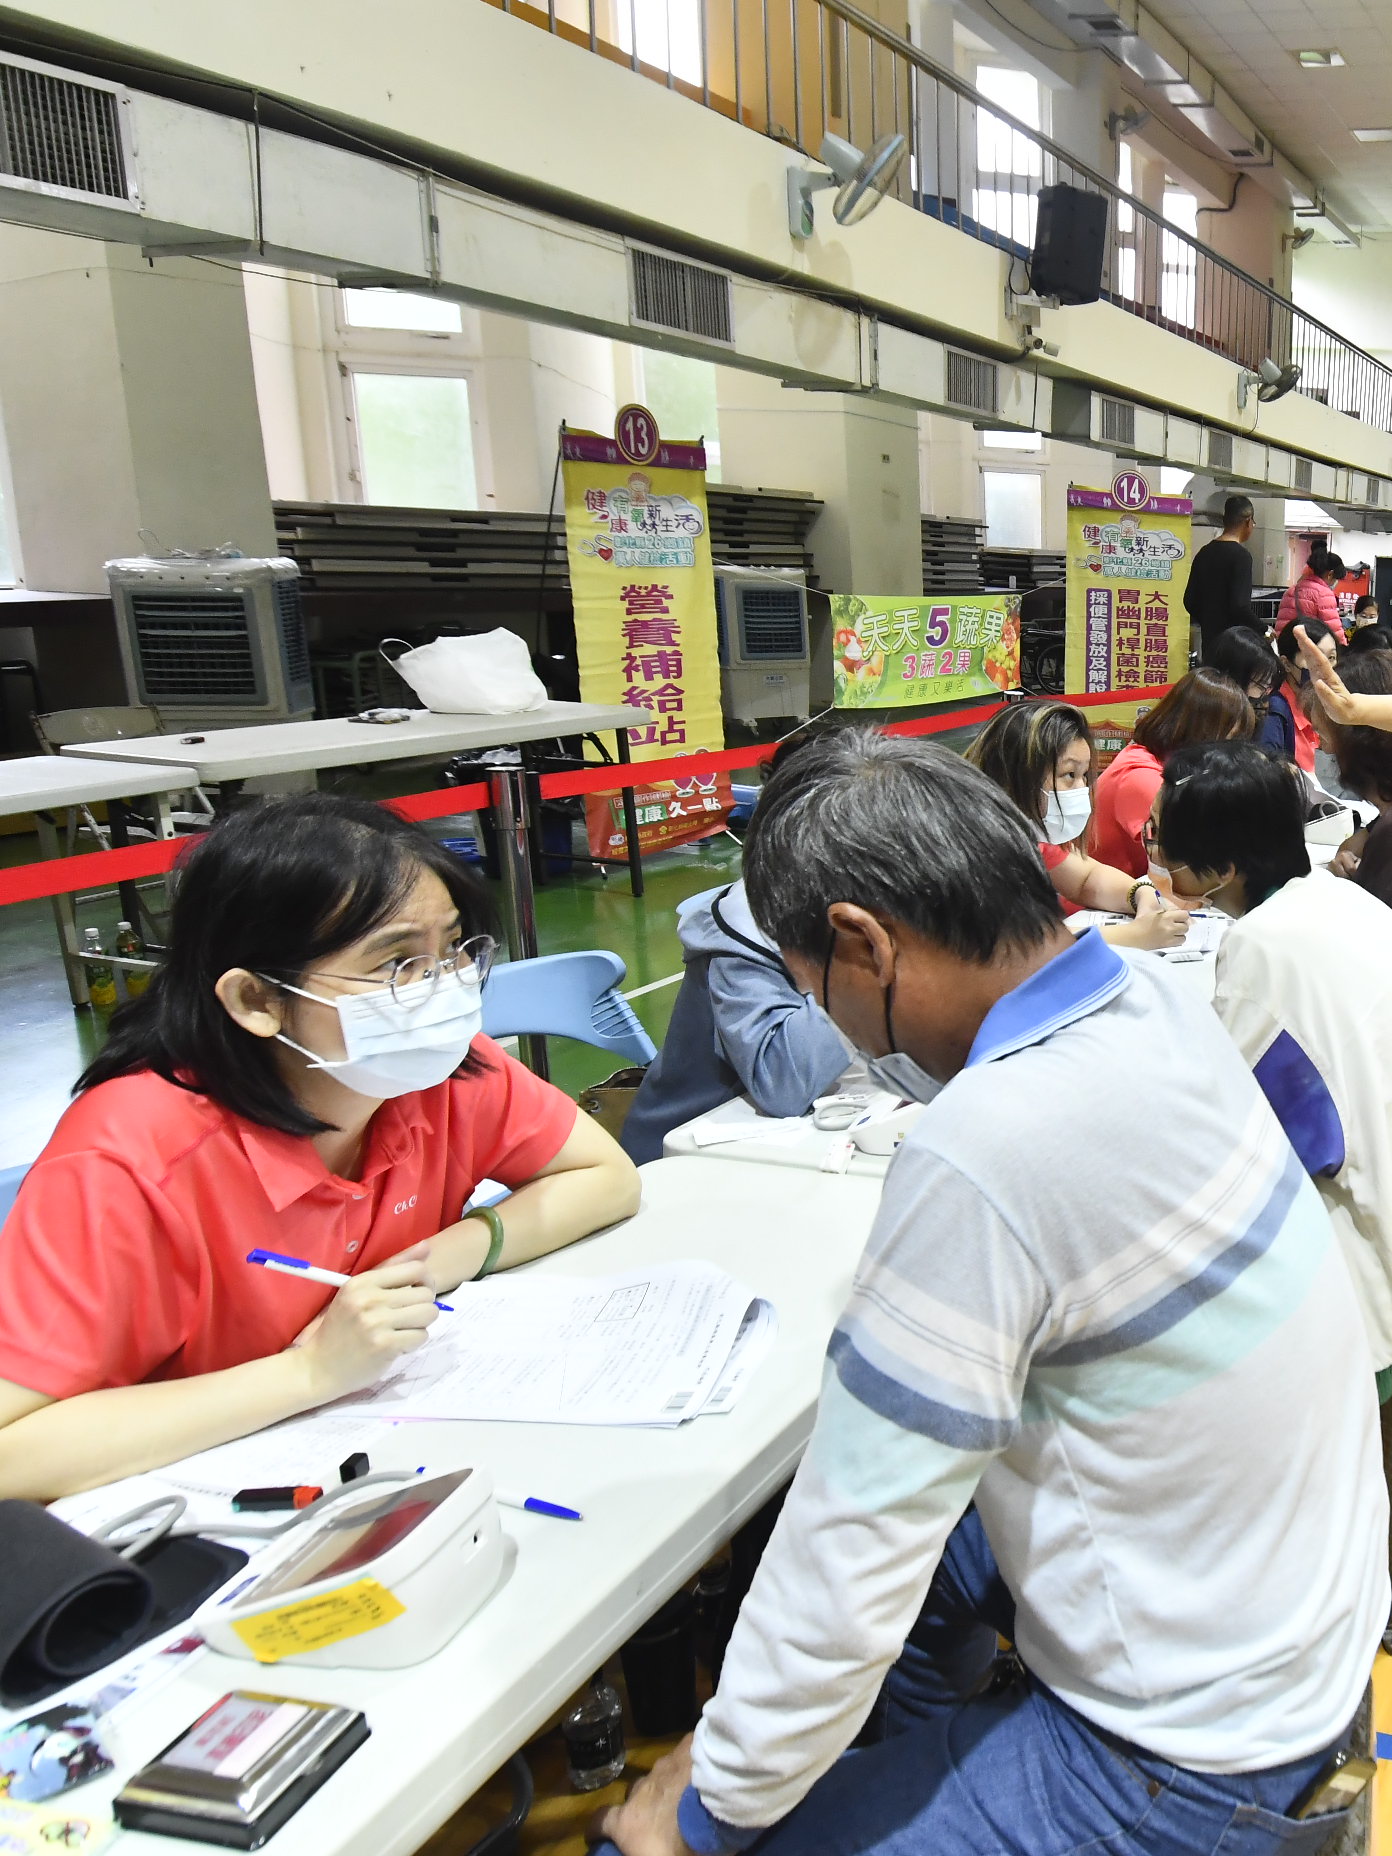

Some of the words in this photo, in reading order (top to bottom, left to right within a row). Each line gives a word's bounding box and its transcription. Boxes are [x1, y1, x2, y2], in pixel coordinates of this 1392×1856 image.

[625, 415, 649, 455] 13
[1120, 477, 1140, 503] 14
[1144, 591, 1169, 687] 大腸直腸癌篩
[620, 584, 687, 747] 營養補給站
[902, 651, 971, 680] 3蔬2果
